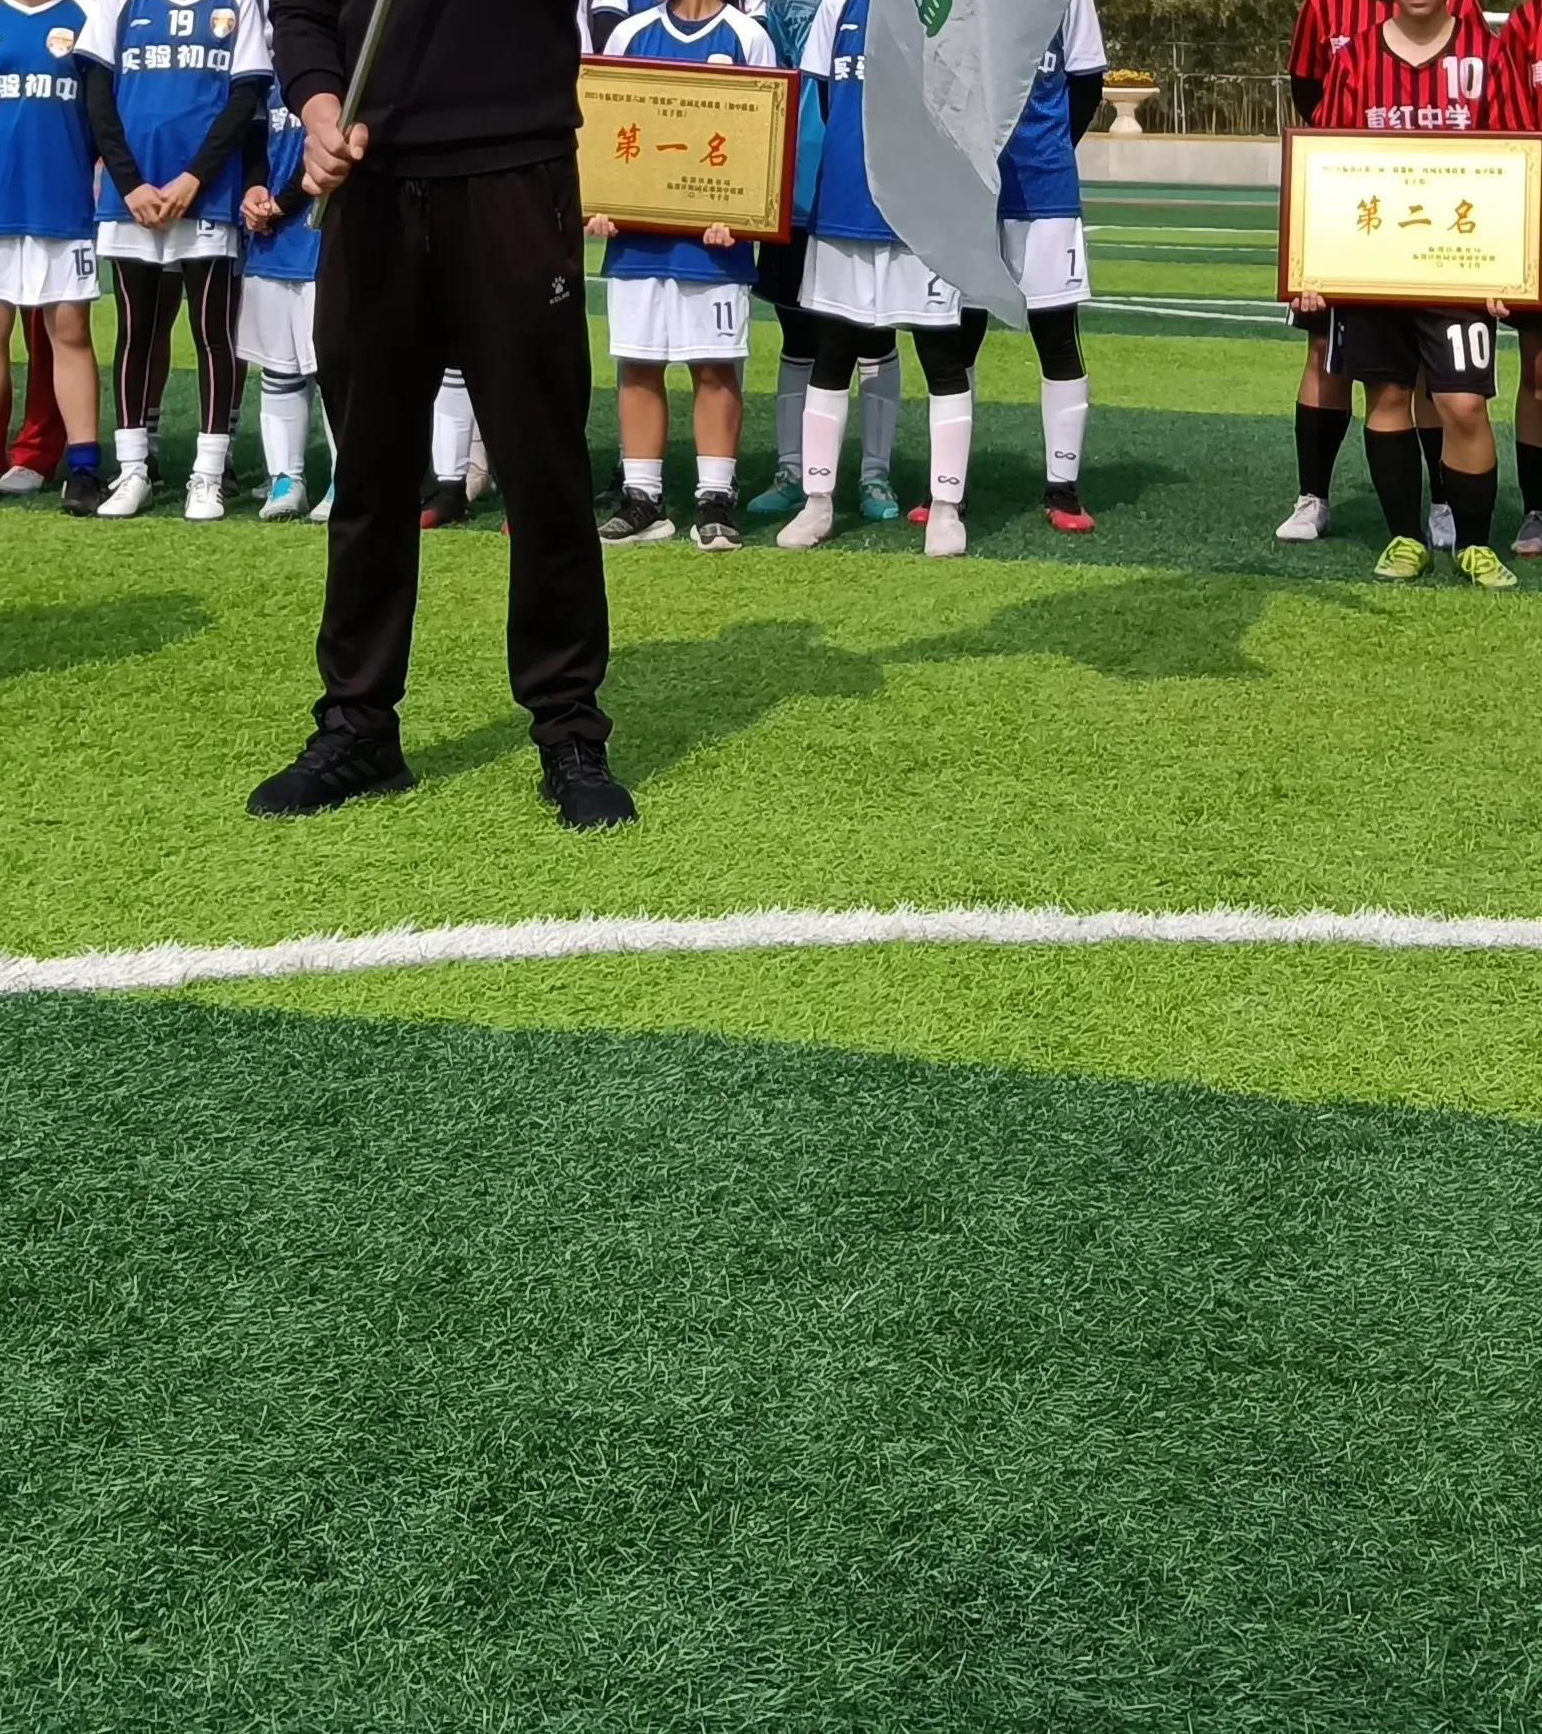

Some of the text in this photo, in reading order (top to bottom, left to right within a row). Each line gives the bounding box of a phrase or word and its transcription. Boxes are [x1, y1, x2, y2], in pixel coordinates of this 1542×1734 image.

[168, 9, 194, 36] 19
[121, 44, 231, 75] 实验初中
[1443, 55, 1483, 100] 10
[1365, 104, 1472, 130] 育红中学
[614, 122, 728, 166] 第一名
[1356, 195, 1476, 235] 第二名
[71, 247, 94, 276] 16
[1067, 249, 1076, 277] 1
[713, 301, 734, 331] 11
[1446, 321, 1490, 371] 10
